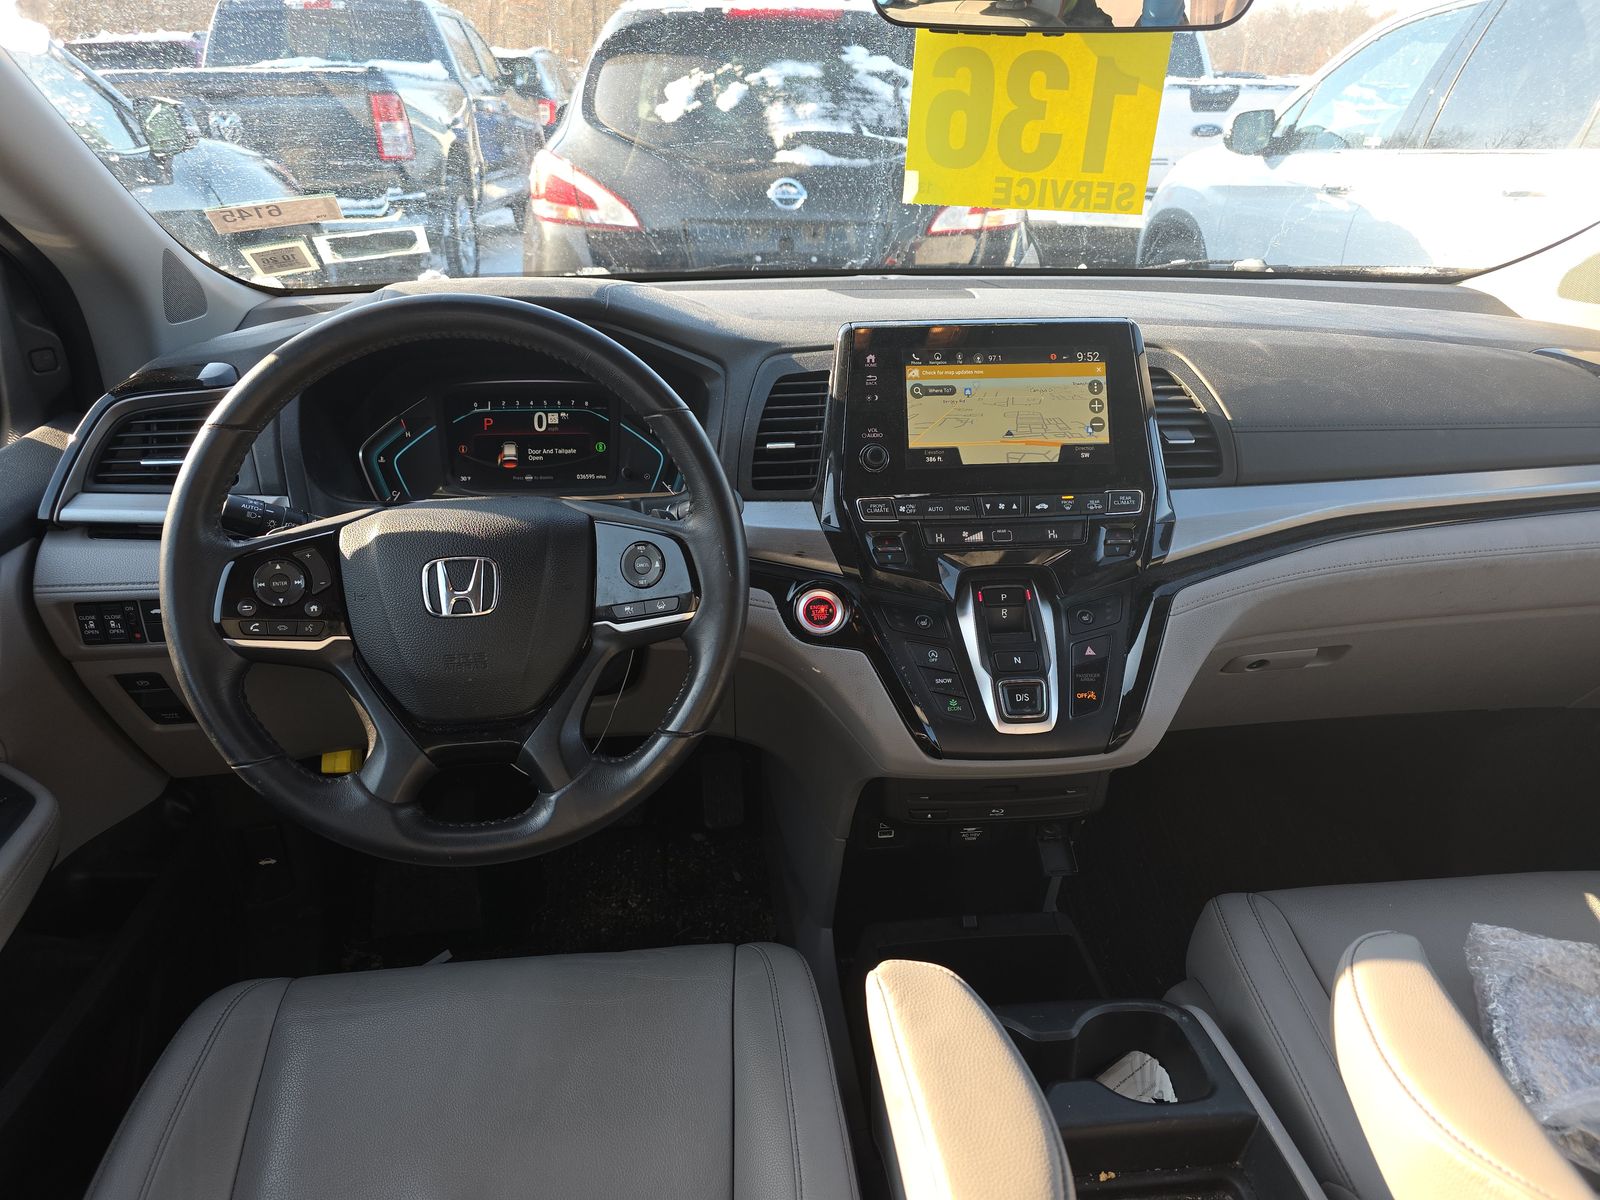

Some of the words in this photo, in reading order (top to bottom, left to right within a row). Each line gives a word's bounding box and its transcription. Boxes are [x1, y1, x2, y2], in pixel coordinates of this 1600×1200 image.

[1076, 351, 1100, 362] 9:52
[483, 417, 494, 431] P
[533, 411, 547, 432] 0
[555, 447, 577, 456] Tailgate
[528, 454, 544, 462] Open
[241, 503, 259, 511] AUTO
[1001, 593, 1007, 601] P
[1001, 608, 1008, 616] R
[1013, 656, 1022, 664] N
[1015, 693, 1030, 702] D/S
